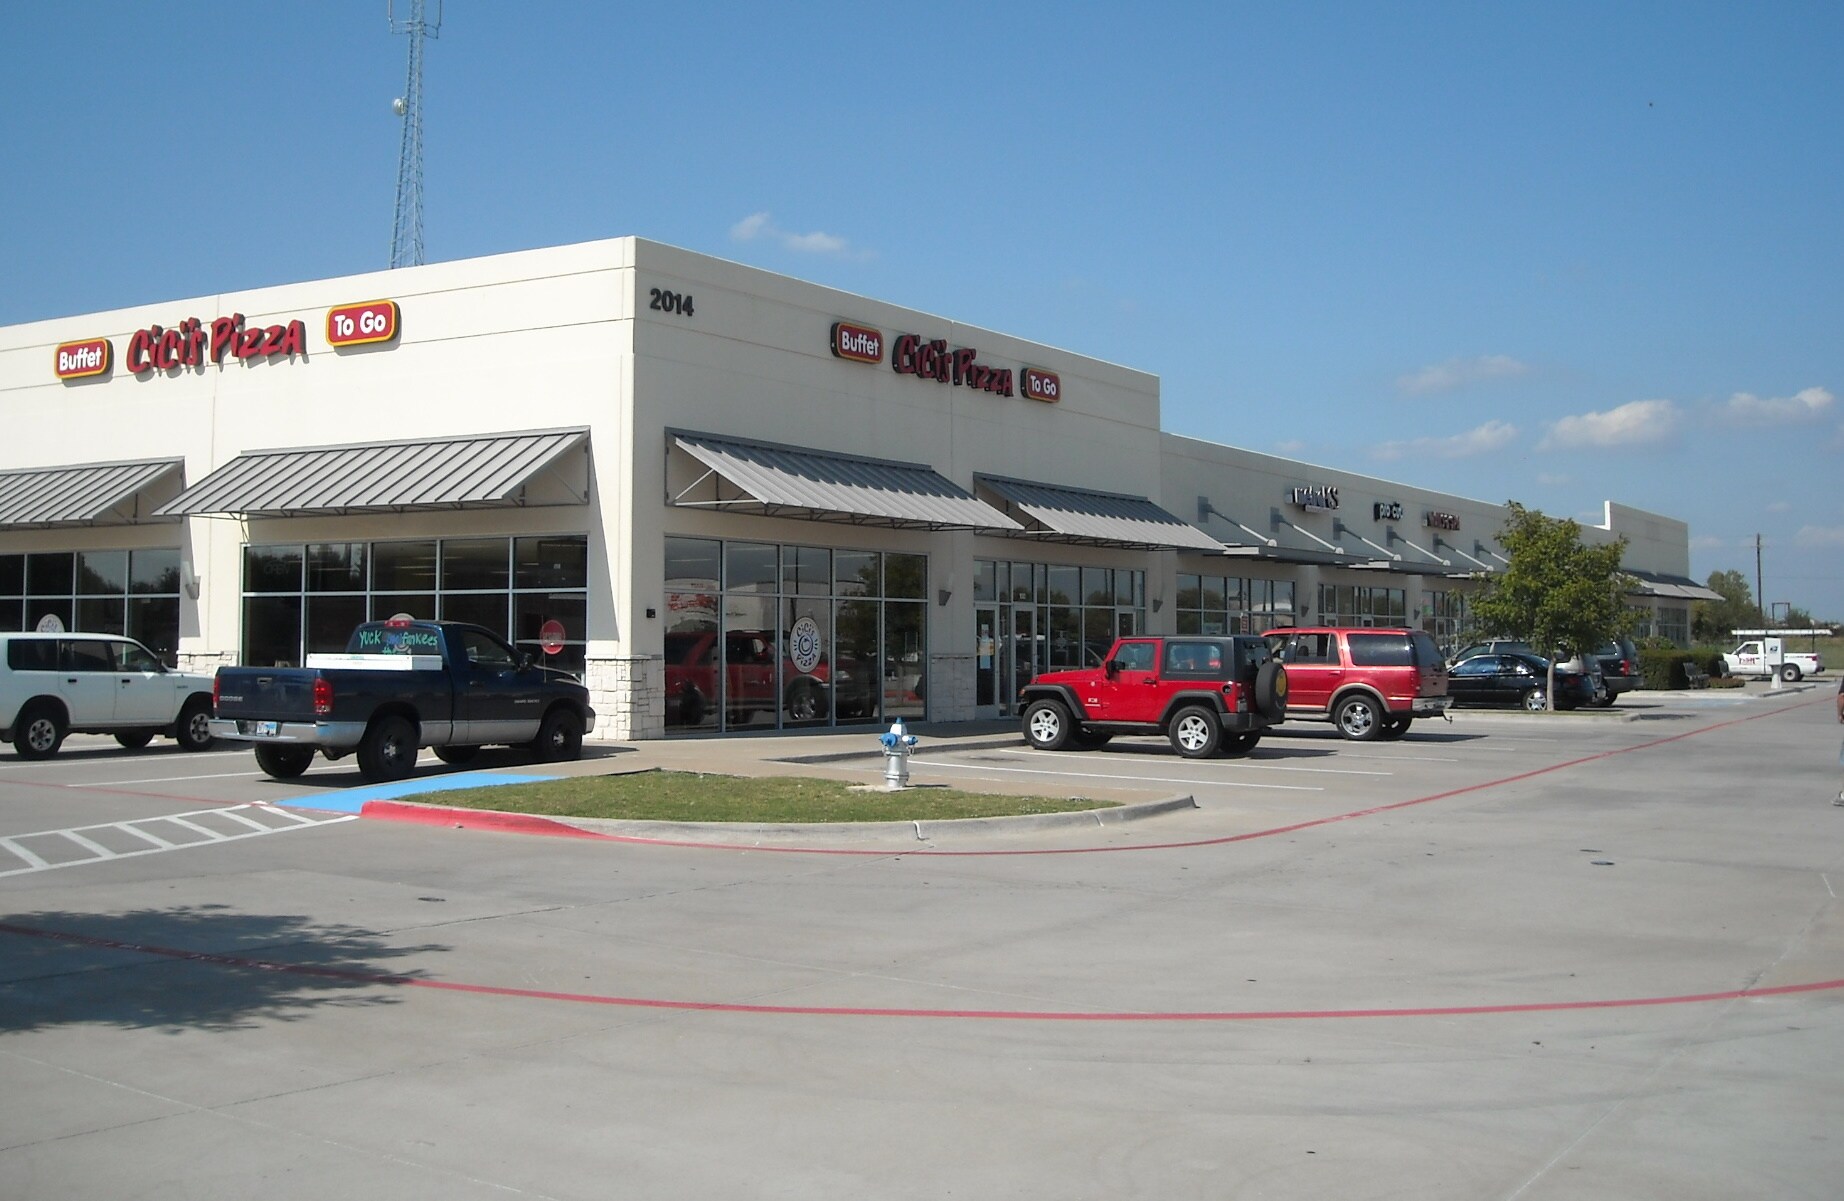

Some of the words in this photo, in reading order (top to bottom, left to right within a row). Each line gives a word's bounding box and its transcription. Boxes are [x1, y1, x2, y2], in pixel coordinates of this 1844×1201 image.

[650, 288, 694, 317] 2014
[334, 314, 351, 336] To
[360, 310, 386, 333] Go
[841, 330, 880, 357] Buffet
[59, 346, 103, 372] Buffet
[1030, 375, 1042, 393] To
[1043, 377, 1057, 396] Go
